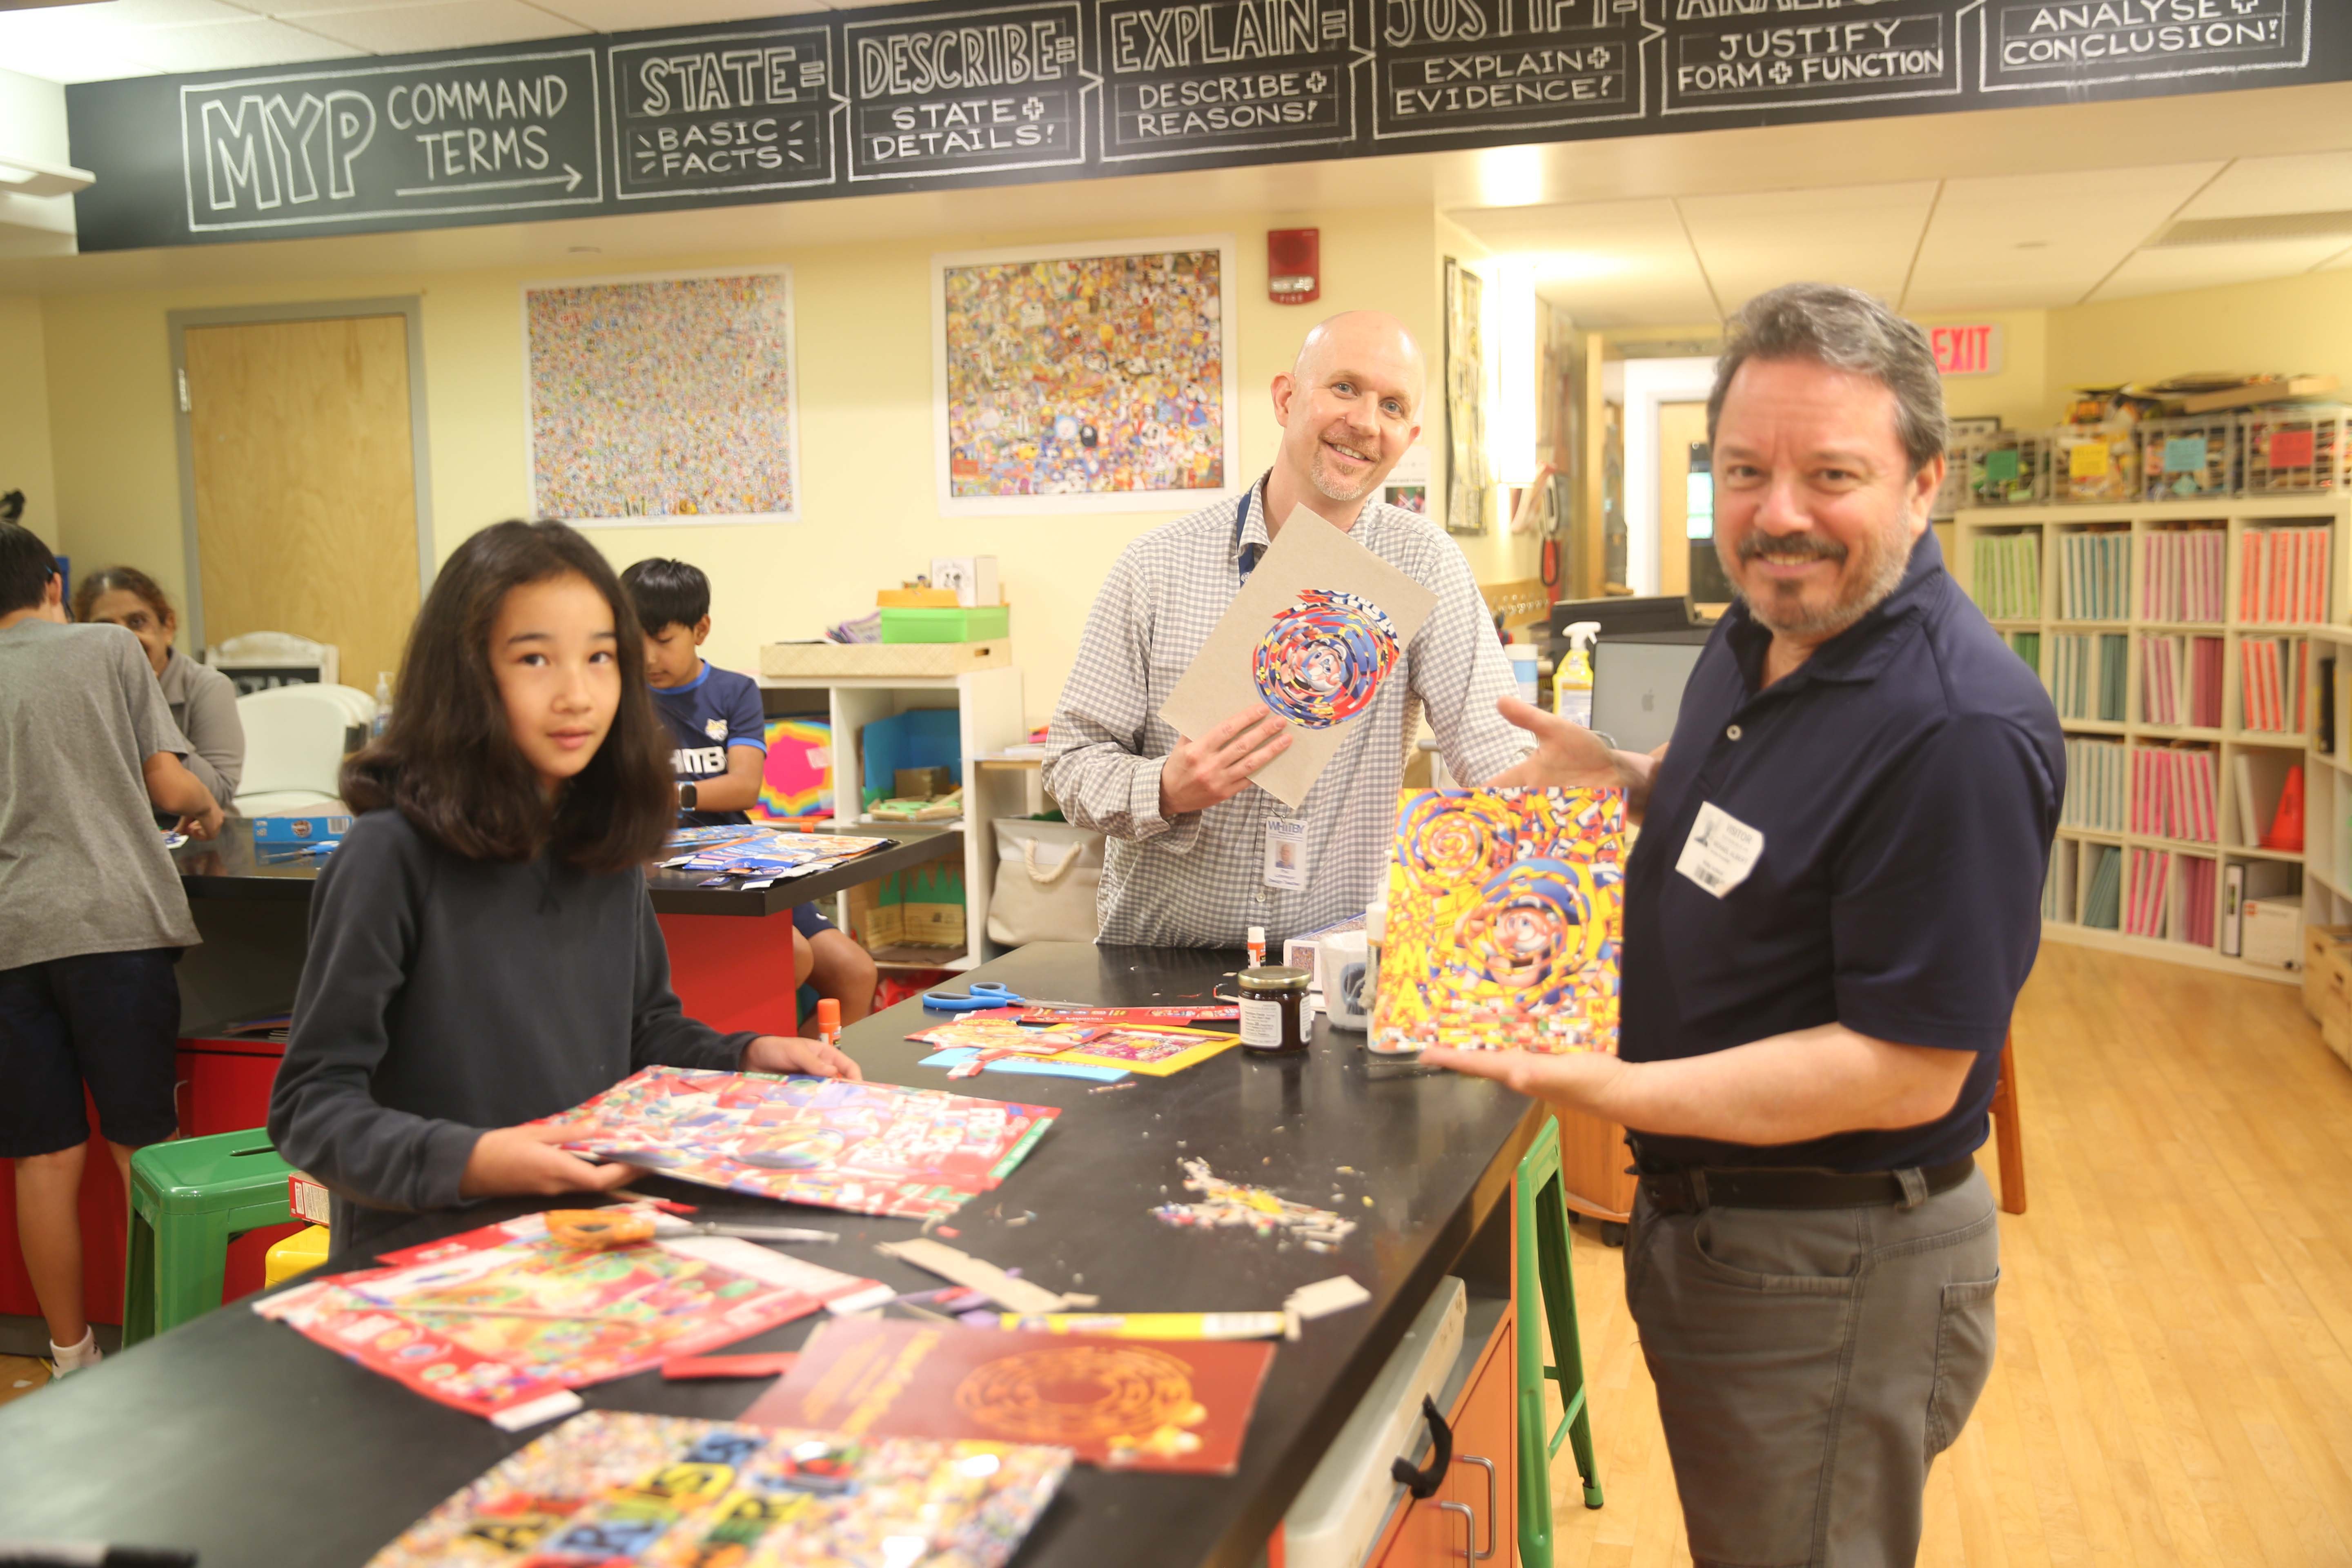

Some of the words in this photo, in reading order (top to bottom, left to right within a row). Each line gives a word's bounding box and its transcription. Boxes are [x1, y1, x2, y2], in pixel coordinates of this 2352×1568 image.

[1718, 18, 1901, 61] JUSTIFY
[2004, 18, 2279, 65] CONCLUSION!
[1678, 61, 1763, 91] FORM
[1802, 49, 1944, 82] FUNCTION
[388, 75, 567, 130] COMMAND
[1396, 75, 1613, 114] EVIDENCE!
[658, 118, 778, 151] BASIC
[1138, 100, 1318, 137] REASONS!
[202, 90, 377, 211] MYP
[416, 126, 548, 180] TERMS
[662, 146, 782, 177] FACTS
[872, 124, 1055, 161] DETAILS!
[1931, 326, 1993, 374] EXIT
[1268, 820, 1305, 833] WHITBY
